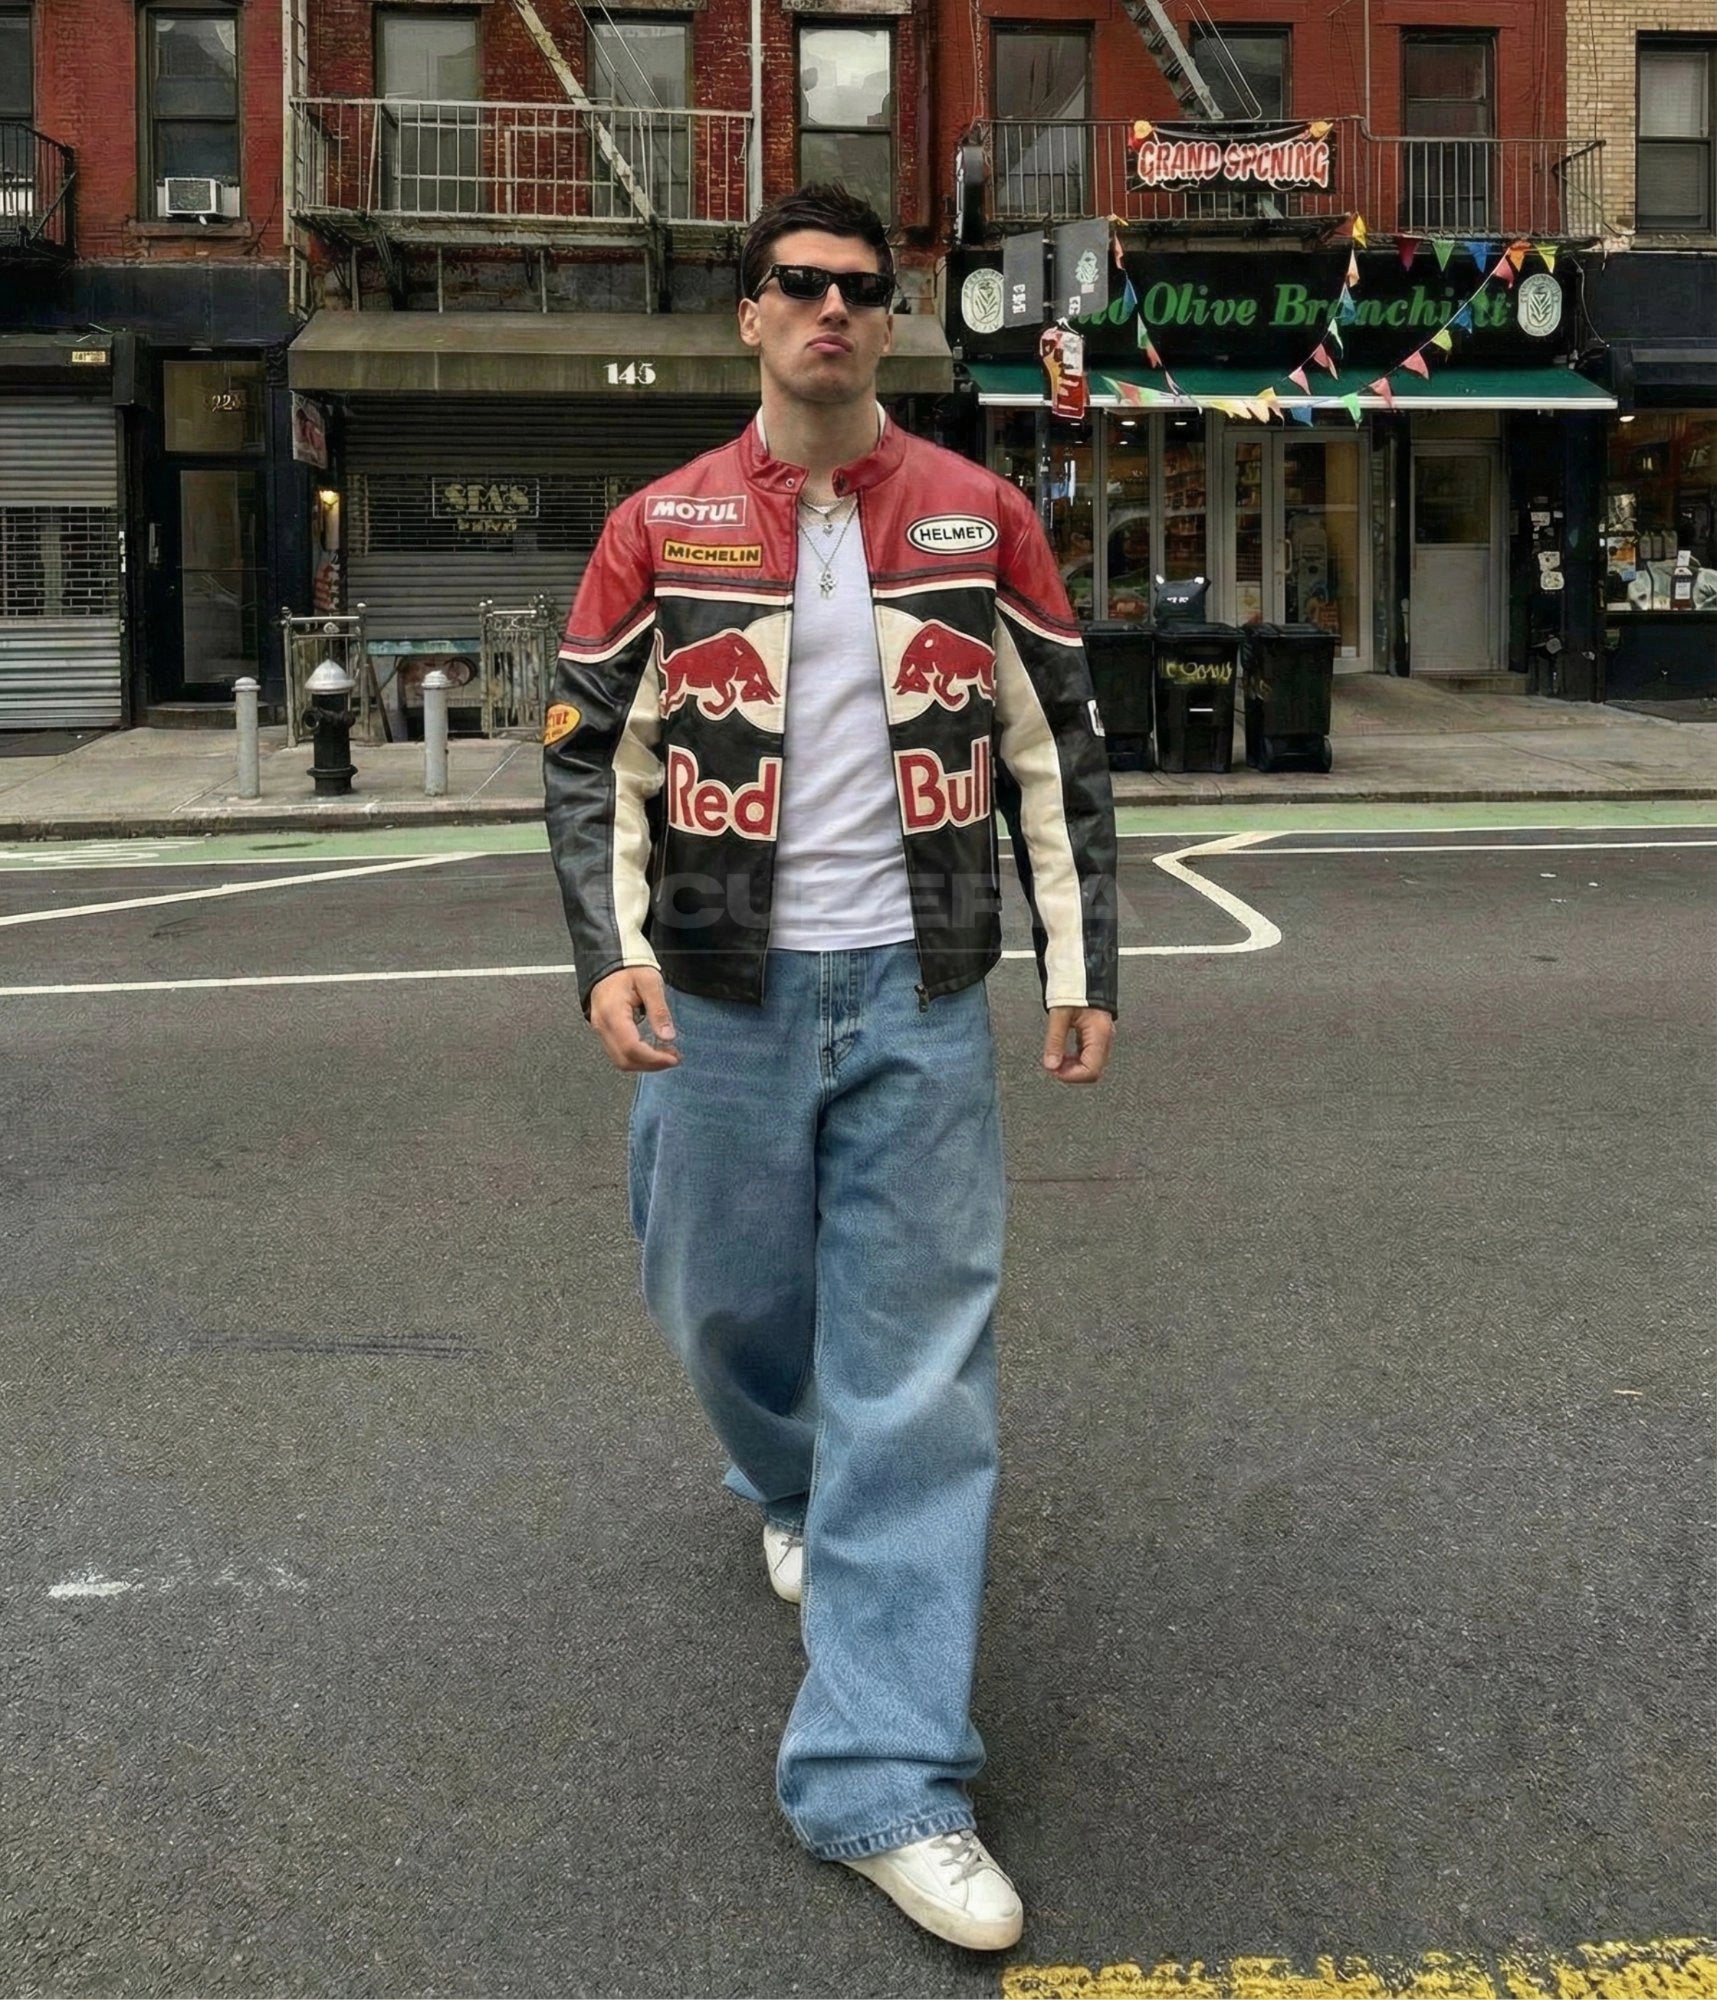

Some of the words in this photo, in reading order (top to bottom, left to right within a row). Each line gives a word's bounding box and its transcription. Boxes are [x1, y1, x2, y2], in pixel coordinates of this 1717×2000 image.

[1138, 141, 1221, 185] GRAND
[1143, 281, 1258, 326] Olive
[603, 362, 656, 385] 145
[651, 500, 738, 522] MOTUL
[919, 526, 984, 541] HELMET
[667, 545, 759, 562] MICHELIN
[669, 750, 777, 836] Red
[898, 741, 988, 828] Bull
